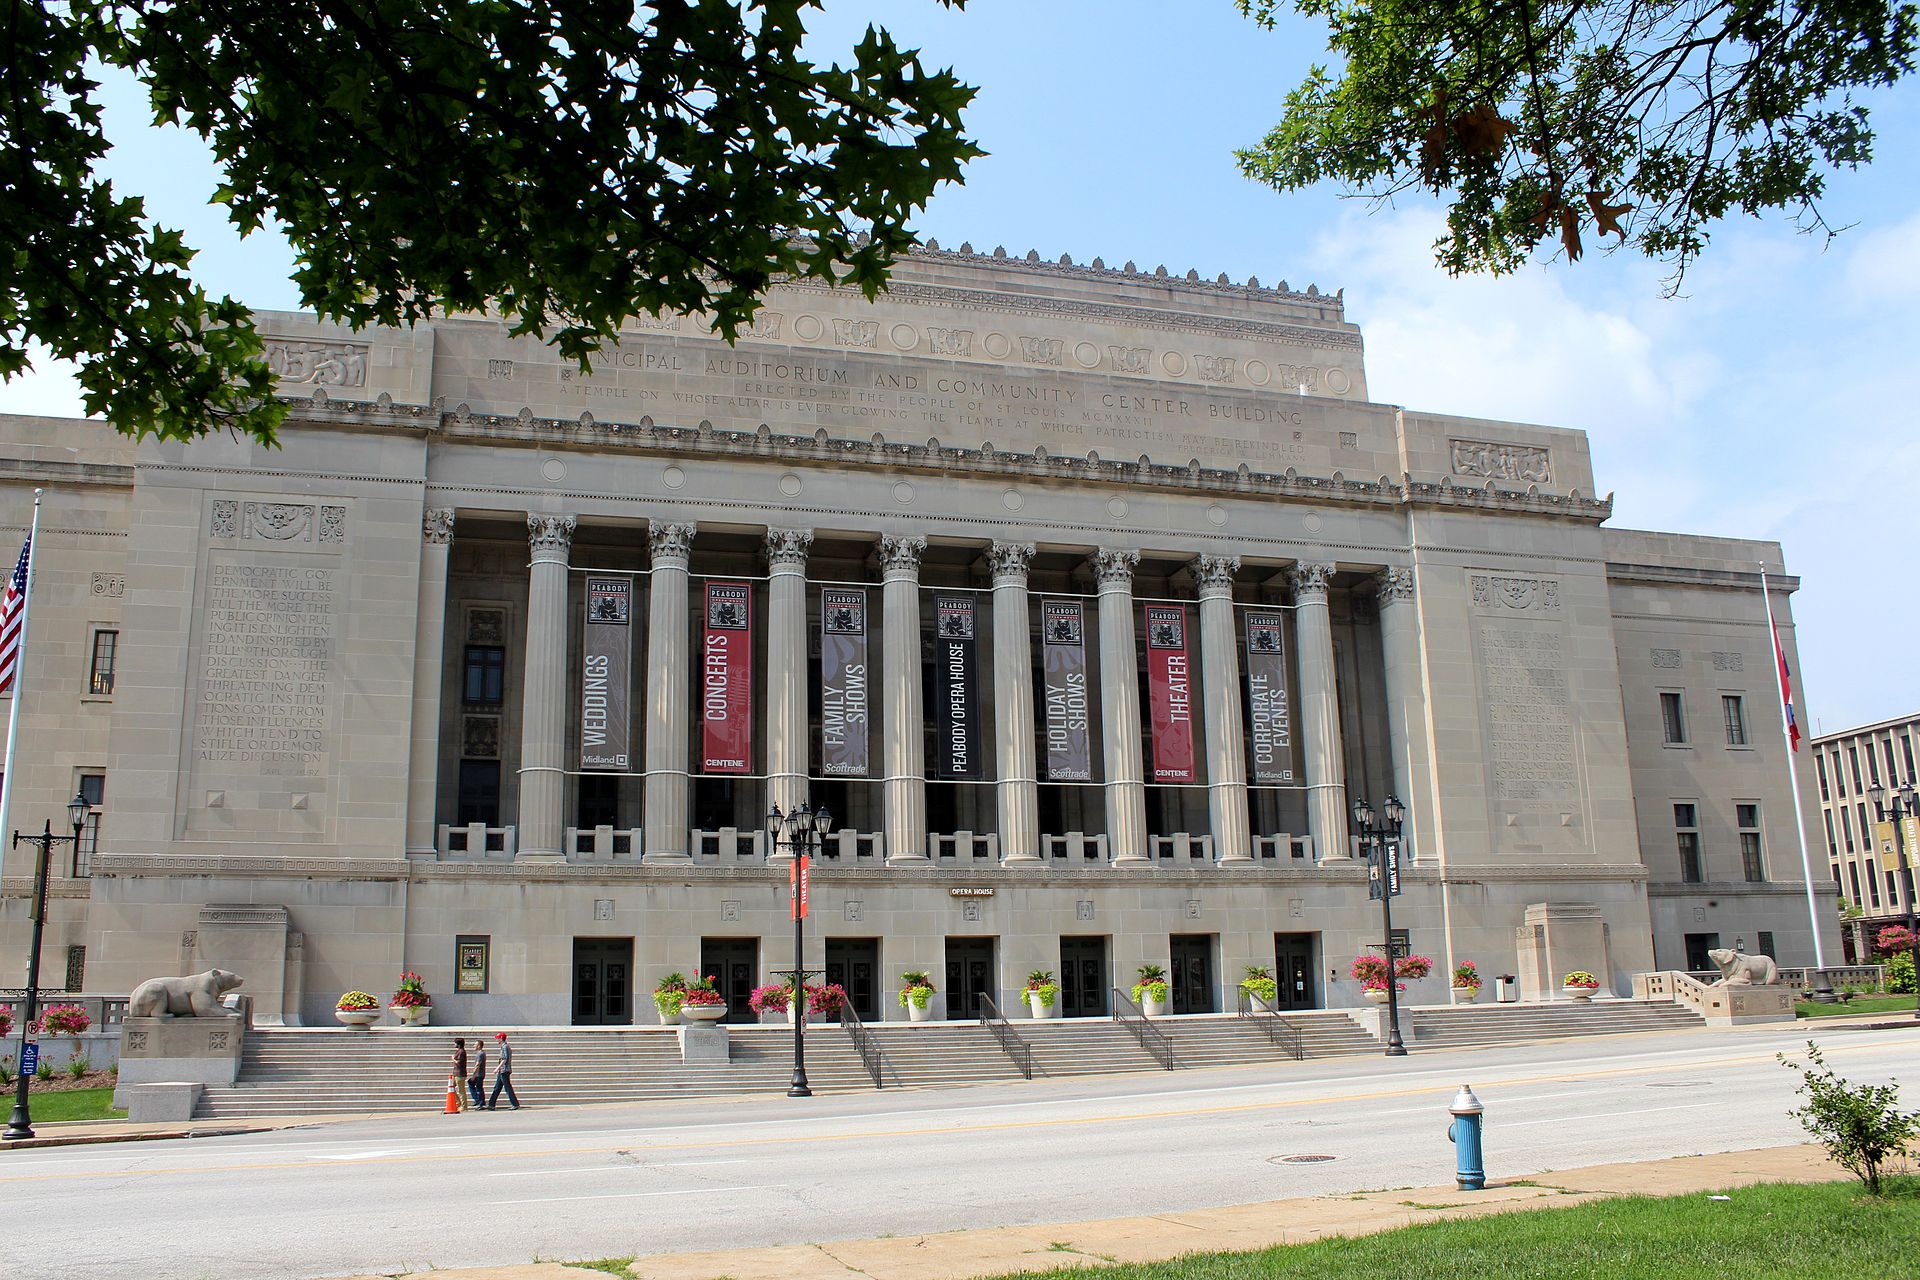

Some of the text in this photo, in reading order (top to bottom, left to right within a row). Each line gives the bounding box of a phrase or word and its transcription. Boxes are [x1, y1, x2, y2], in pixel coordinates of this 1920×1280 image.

[705, 360, 848, 384] AUDITORIUM
[874, 373, 918, 390] AND
[937, 379, 1076, 403] COMMUNITY
[1102, 394, 1192, 417] CENTER
[1209, 404, 1302, 425] BUILDING
[745, 383, 818, 397] ERECTED
[831, 390, 849, 400] BY
[858, 392, 886, 403] THE
[900, 396, 956, 409] PEOPLE
[968, 402, 984, 411] OF
[1023, 406, 1066, 418] LOUIS
[1082, 412, 1152, 426] MCMXXXII
[560, 385, 568, 394] A
[575, 386, 629, 398] TEMPLE
[639, 390, 659, 400] ON
[672, 393, 719, 404] WHOSE
[728, 398, 770, 408] ALTAR
[780, 400, 790, 410] IS
[798, 402, 832, 414] EVER
[841, 406, 908, 420] GLOWING
[921, 412, 946, 422] THE
[959, 415, 1004, 428] FLAME
[1015, 420, 1029, 430] AT
[1040, 422, 1084, 434] WHICH
[1096, 426, 1174, 442] PATRIOTISM
[1182, 434, 1207, 444] MAY
[215, 565, 298, 578] DEMOCRATIC
[214, 577, 333, 591] ERNMENT WILL BE
[213, 588, 332, 602] THE MORE SUCCESS
[212, 600, 330, 613] FUL THE MORE THE
[211, 611, 256, 621] PUBLIC
[257, 613, 306, 623] OPINION
[260, 624, 330, 636] ENLIGHTEN
[207, 669, 326, 682] GREATEST DANGER
[706, 634, 728, 721] CONCERTS
[205, 680, 325, 693] THREATENING DEM
[1168, 656, 1189, 724] THEATER
[204, 692, 325, 704] OCRATIC INSTITU
[584, 655, 608, 746] WEDDINGS
[846, 664, 865, 724] SHOWS
[950, 642, 967, 772] PEABODY OPERA HOUSE
[1066, 673, 1087, 730] SHOWS
[204, 704, 324, 716] TIONS COMES FROM
[824, 686, 844, 745] FAMILY
[203, 715, 323, 728] THOSE INFLUENCES
[1047, 684, 1068, 751] HOLIDAY
[1250, 674, 1273, 764] CORPORATE
[1270, 688, 1290, 747] EVENTS
[201, 727, 321, 739] WHICH TEND TO
[200, 739, 322, 751] STIFLE OR DEMOR
[199, 751, 321, 762] ALIZE DISCUSSION
[583, 756, 614, 764] Midland
[706, 758, 744, 767] CENTENE
[824, 762, 866, 774] Scottrade
[1050, 768, 1088, 779] Scottrade
[1388, 845, 1398, 893] FAMILY SHOWS
